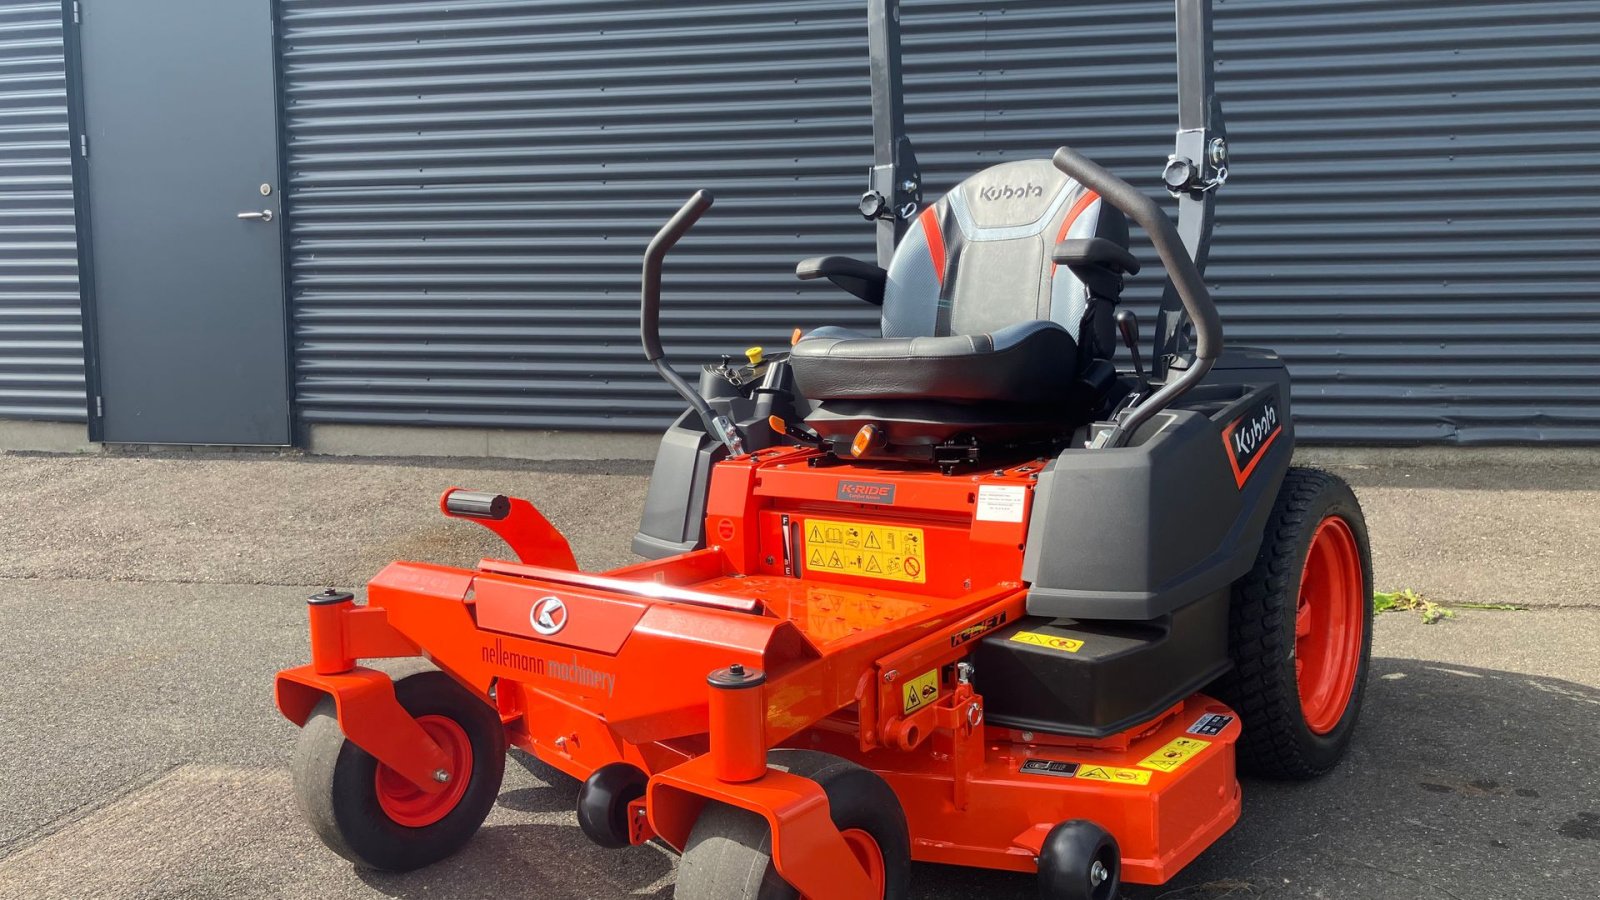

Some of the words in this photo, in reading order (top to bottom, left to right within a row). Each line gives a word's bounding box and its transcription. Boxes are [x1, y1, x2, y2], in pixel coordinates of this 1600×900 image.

[980, 182, 1043, 201] Kubota
[1235, 404, 1276, 454] Kubota
[482, 638, 545, 675] nellemann
[547, 655, 616, 699] machinery
